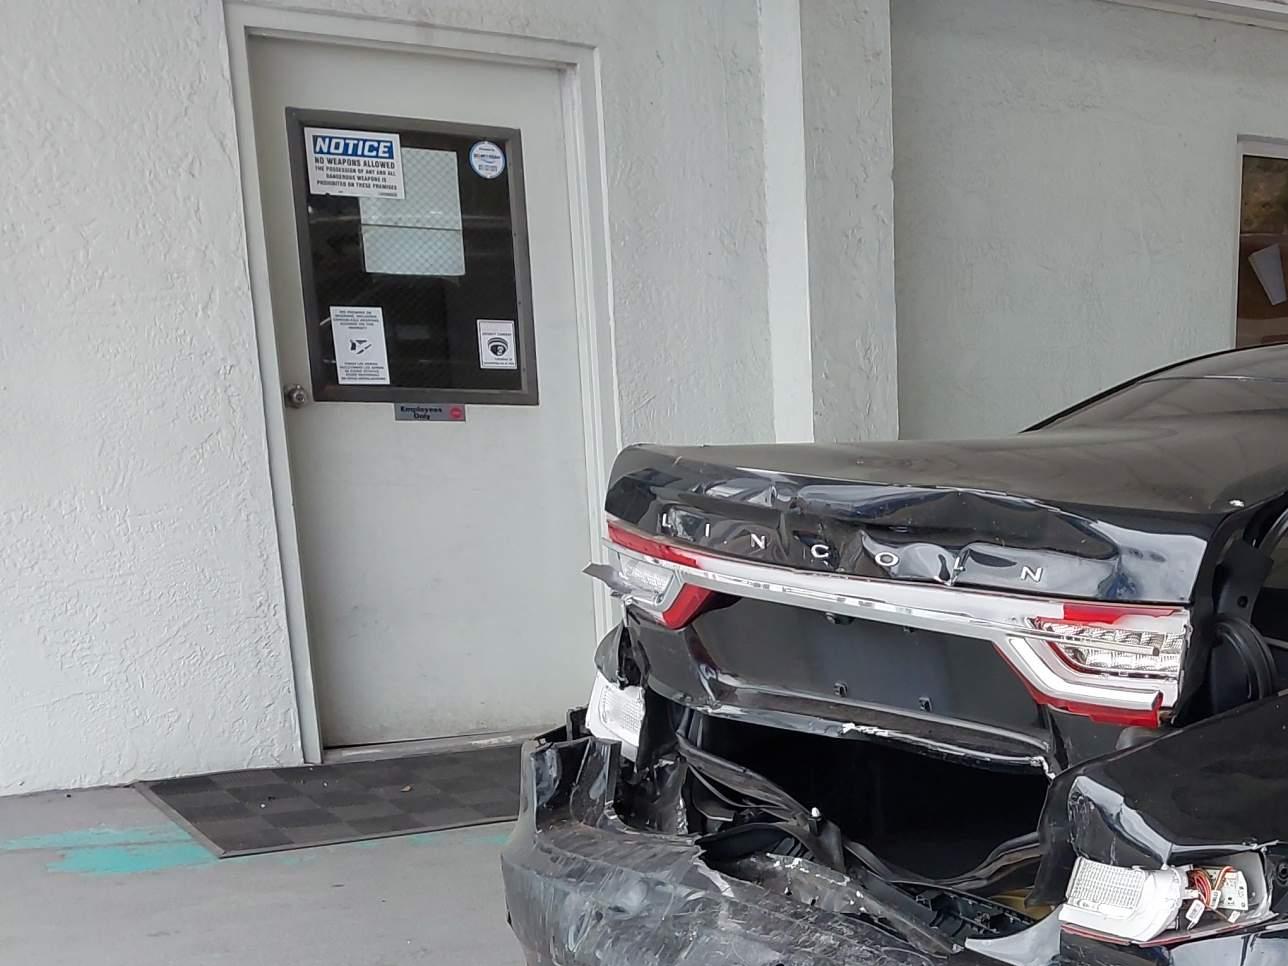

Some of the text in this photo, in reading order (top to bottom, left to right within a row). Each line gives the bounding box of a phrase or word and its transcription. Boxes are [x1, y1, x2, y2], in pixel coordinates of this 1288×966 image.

[315, 137, 391, 157] NOTICE
[314, 156, 396, 170] NO WEAPONS ALLOWED
[326, 166, 356, 174] POSSESSION
[326, 173, 355, 181] DANGEROUS
[372, 183, 397, 191] PREMISES
[400, 406, 442, 414] Employees
[660, 511, 1044, 583] LINCOLN
